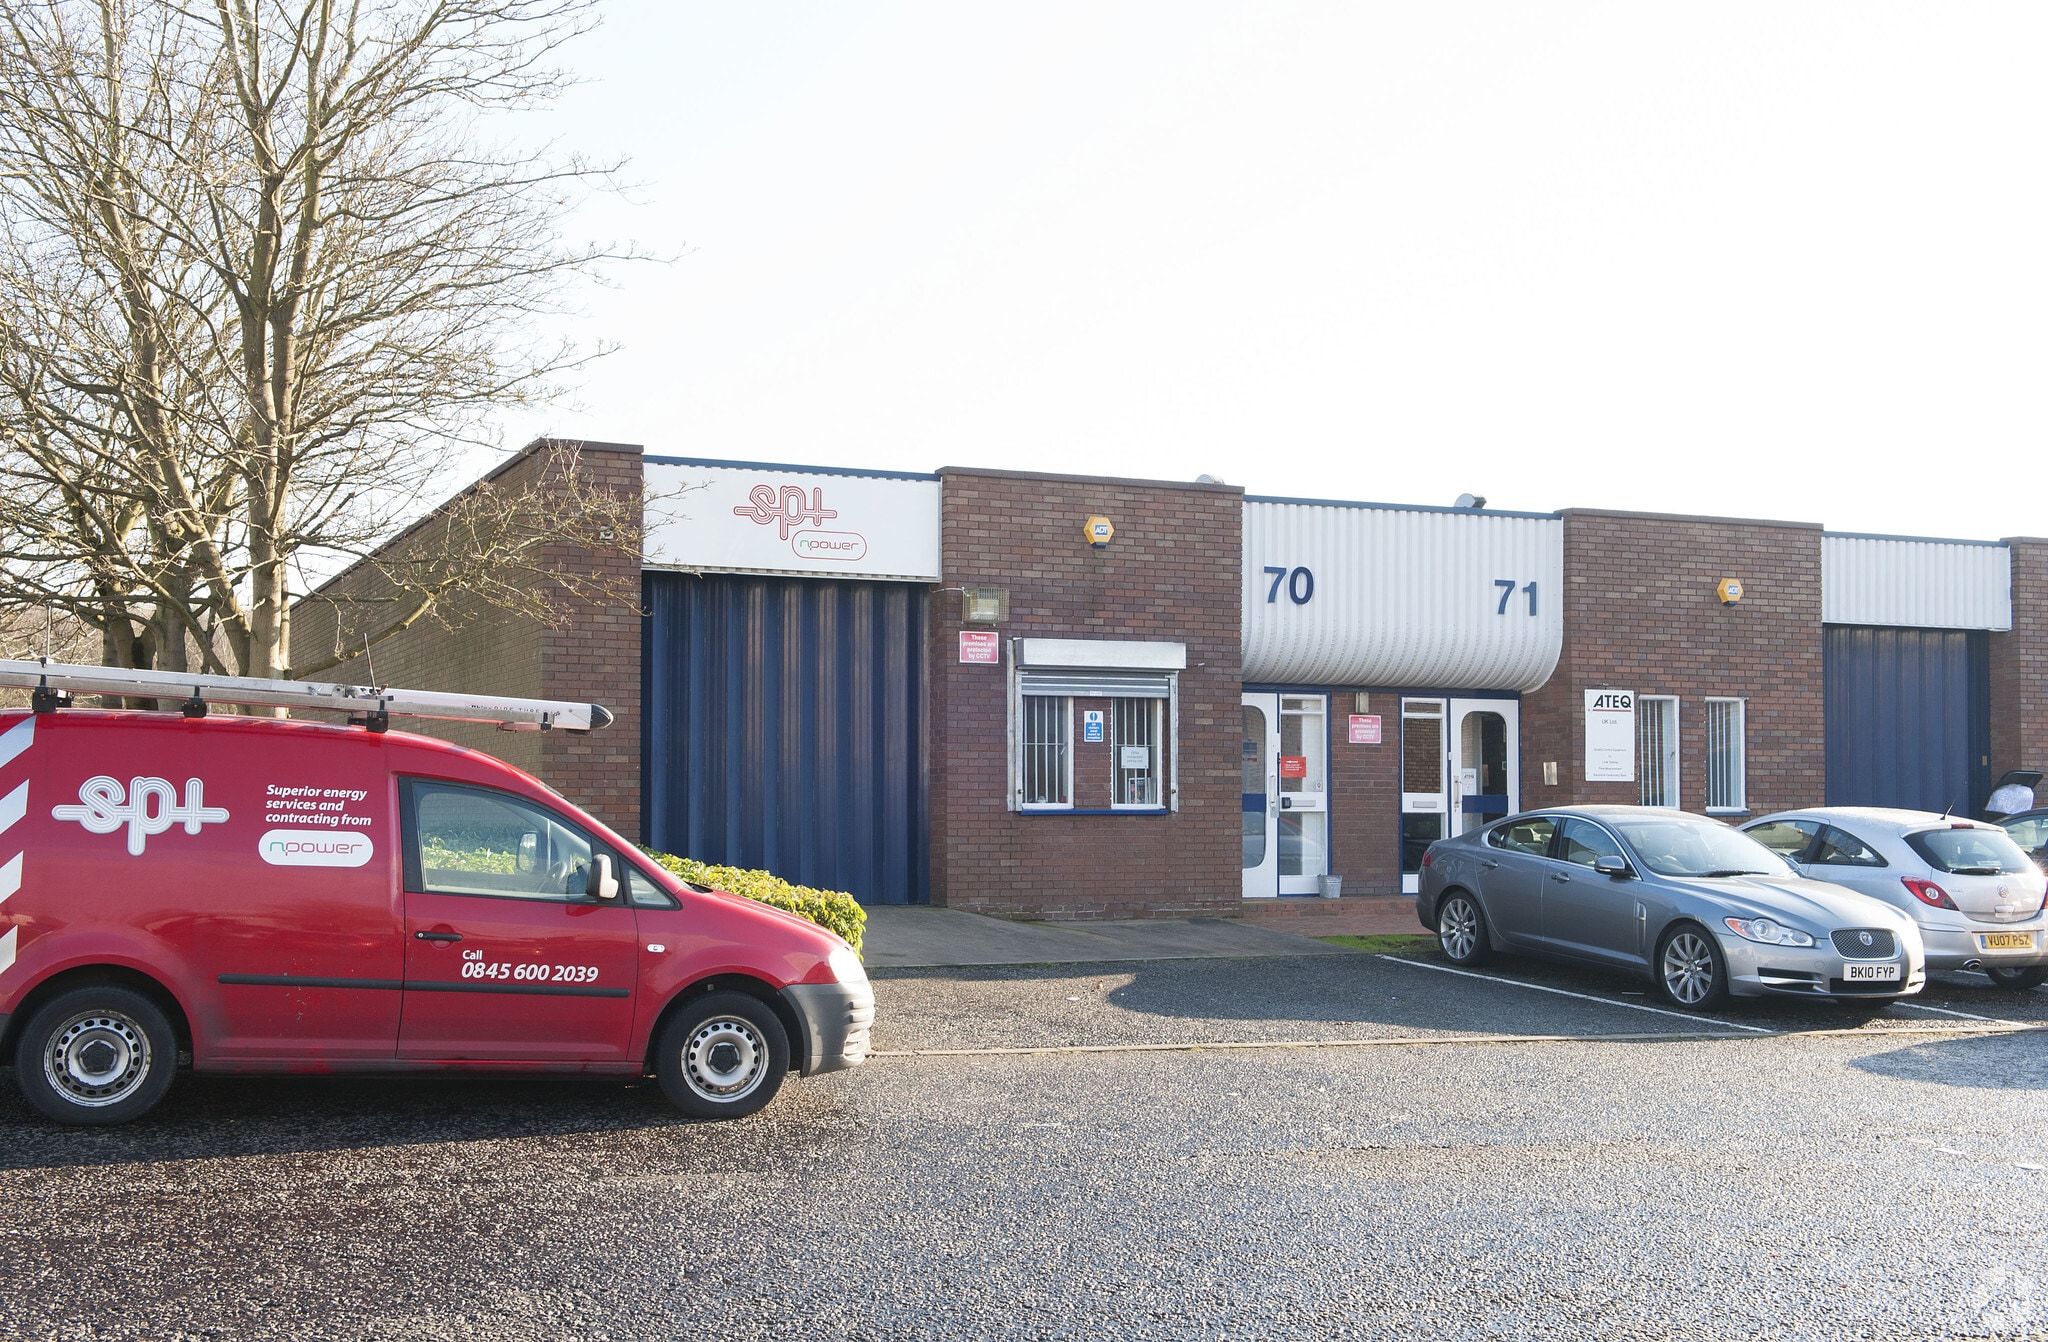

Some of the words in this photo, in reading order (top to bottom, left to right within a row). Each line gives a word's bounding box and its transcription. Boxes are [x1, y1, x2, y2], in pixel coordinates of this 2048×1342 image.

[800, 539, 859, 551] npower
[1263, 566, 1314, 605] 70
[1494, 579, 1537, 617] 71
[1593, 695, 1632, 709] ATEQ
[266, 784, 322, 798] Superior
[323, 788, 368, 802] energy
[265, 798, 317, 810] services
[318, 800, 345, 811] and
[265, 812, 339, 827] contracting
[341, 813, 372, 826] from
[269, 841, 363, 857] npower
[1987, 935, 2010, 946] VU07
[462, 950, 483, 960] Call
[461, 962, 512, 979] 0845
[513, 963, 550, 981] 600
[551, 965, 599, 982] 2039
[1850, 966, 1874, 978] BK10
[1876, 966, 1895, 978] FYP
